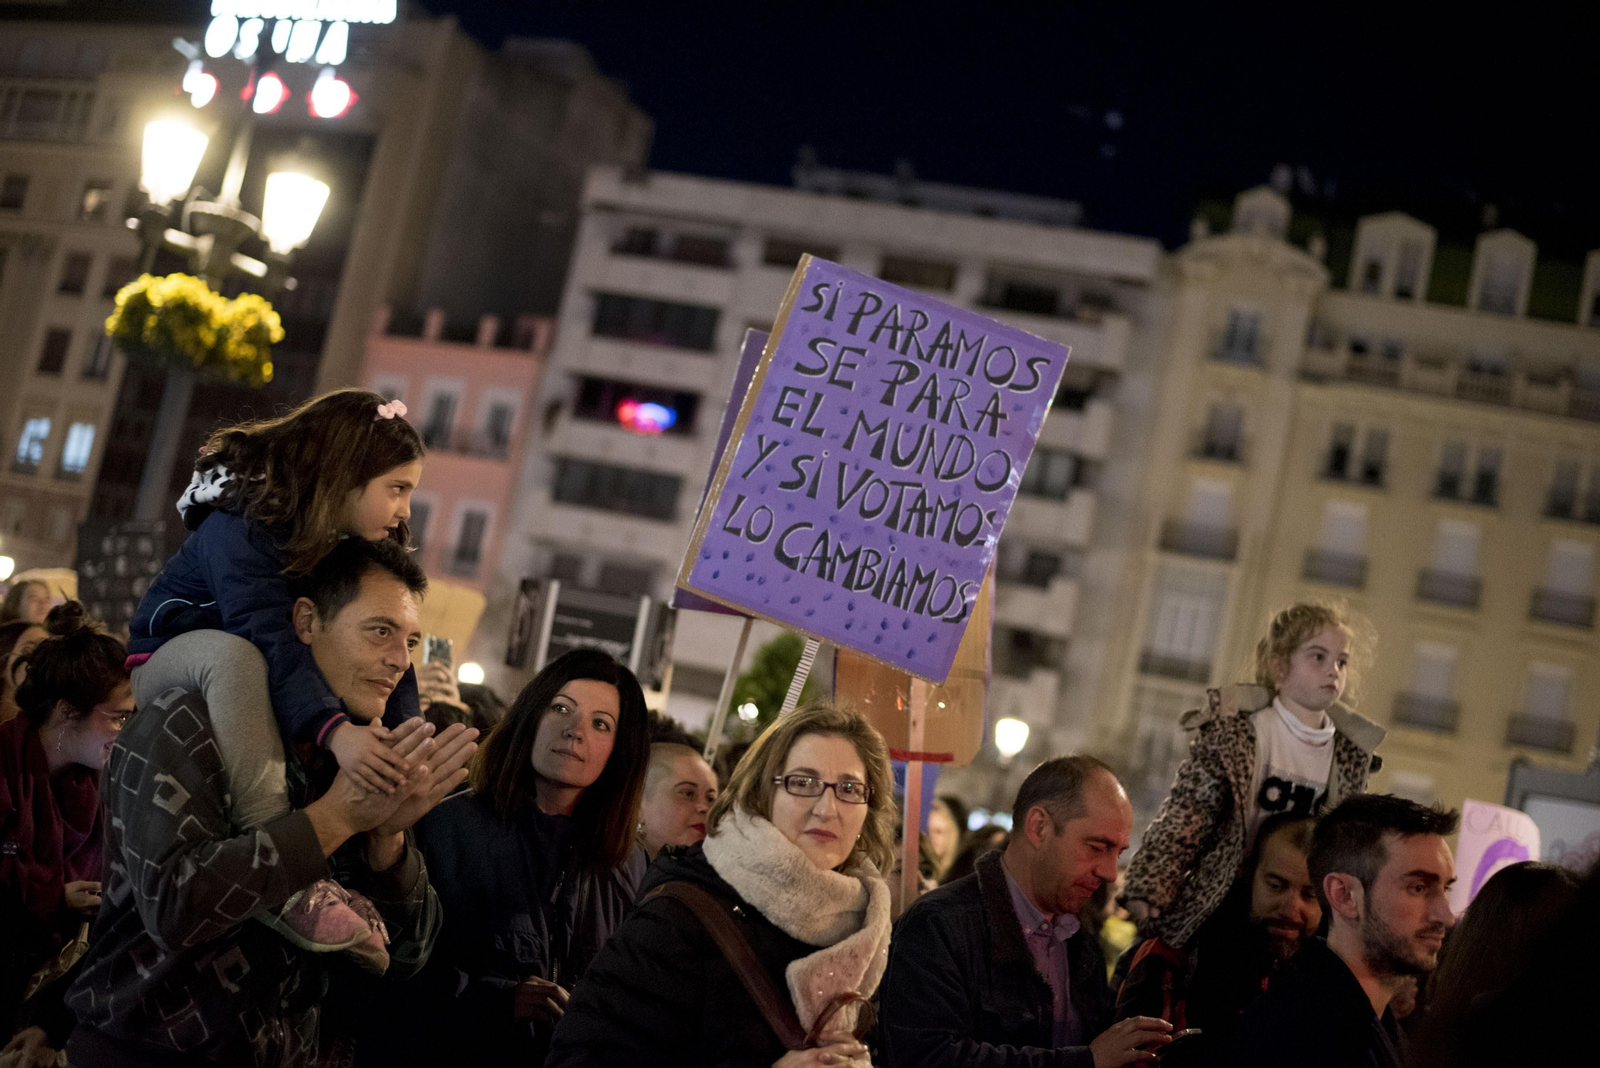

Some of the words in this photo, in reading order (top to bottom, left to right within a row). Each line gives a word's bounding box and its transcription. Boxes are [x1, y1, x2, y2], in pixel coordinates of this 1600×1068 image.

[793, 337, 869, 391] SE
[879, 360, 1010, 439] PARA
[847, 291, 1051, 394] PARAMOS
[741, 434, 781, 480] Y
[836, 461, 999, 548] VOTAMOS
[771, 385, 827, 438] EL
[842, 408, 1012, 494] MUNDO
[721, 494, 774, 545] LO
